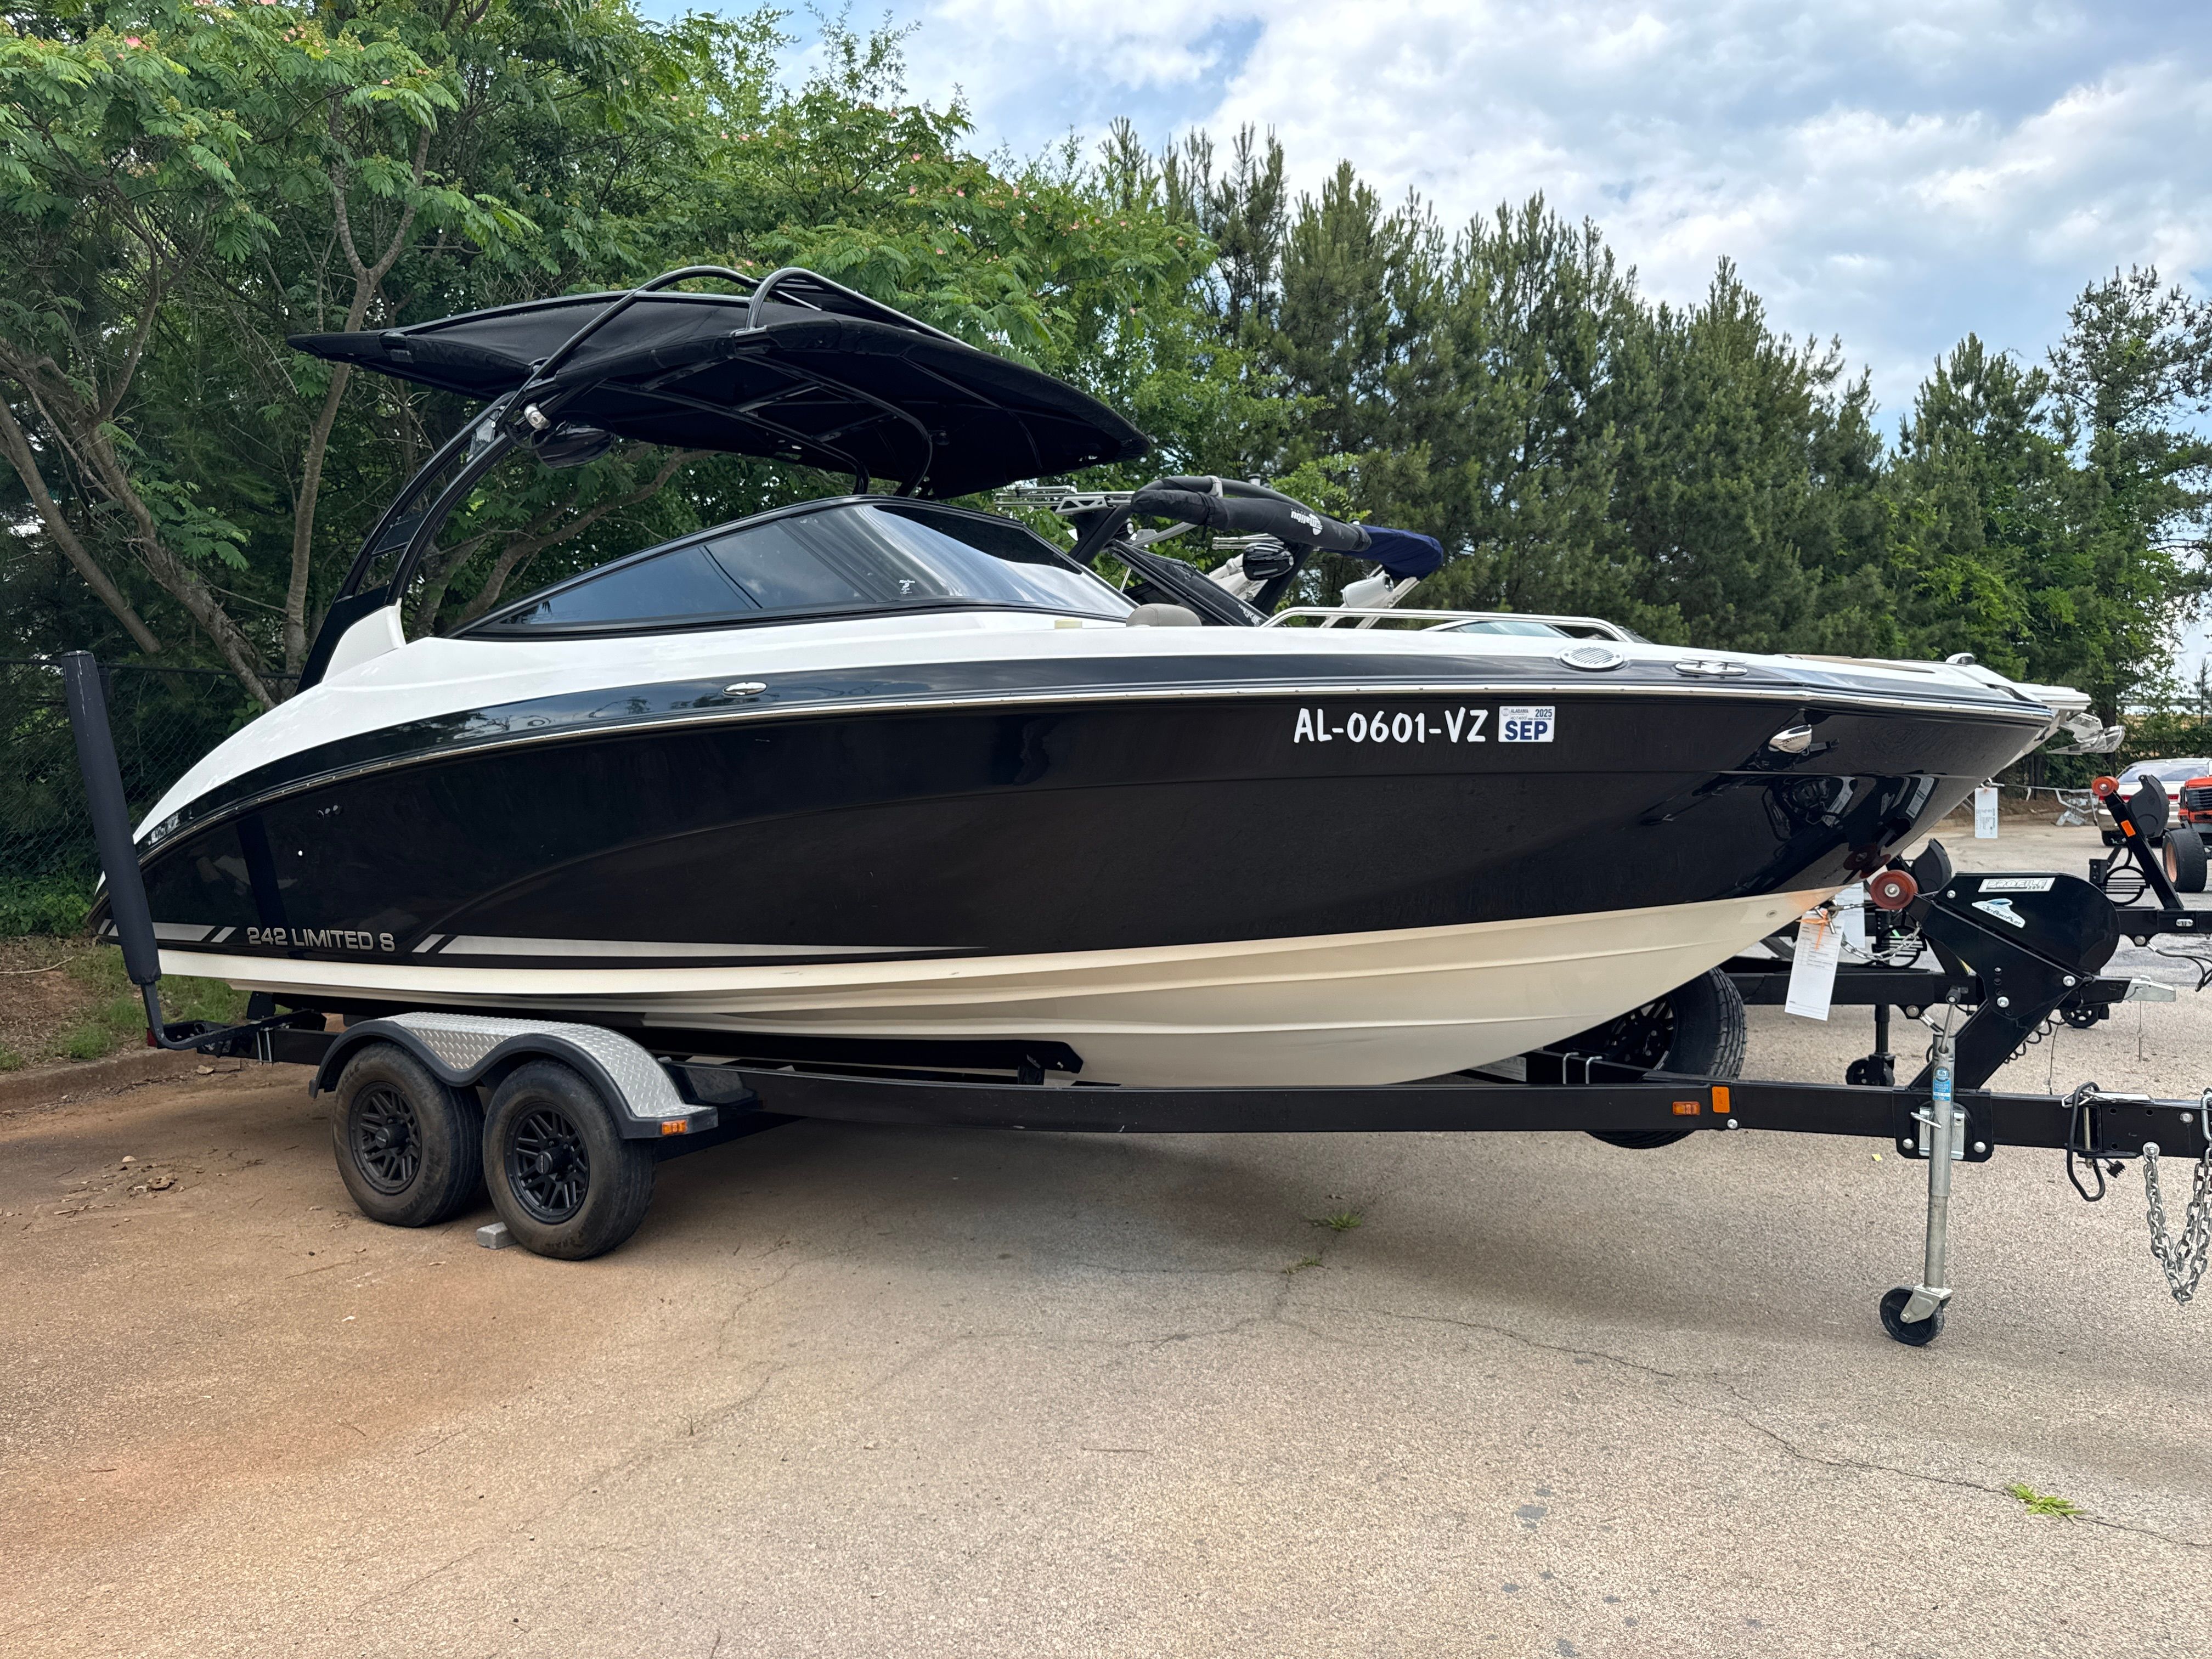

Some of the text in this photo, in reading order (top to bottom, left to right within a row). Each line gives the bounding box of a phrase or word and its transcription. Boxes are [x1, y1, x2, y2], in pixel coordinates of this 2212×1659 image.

[1535, 709, 1552, 717] 2025
[1294, 707, 1488, 743] AL-0601-VZ
[1505, 720, 1548, 740] SEP
[247, 927, 396, 952] 242 LIMITED S
